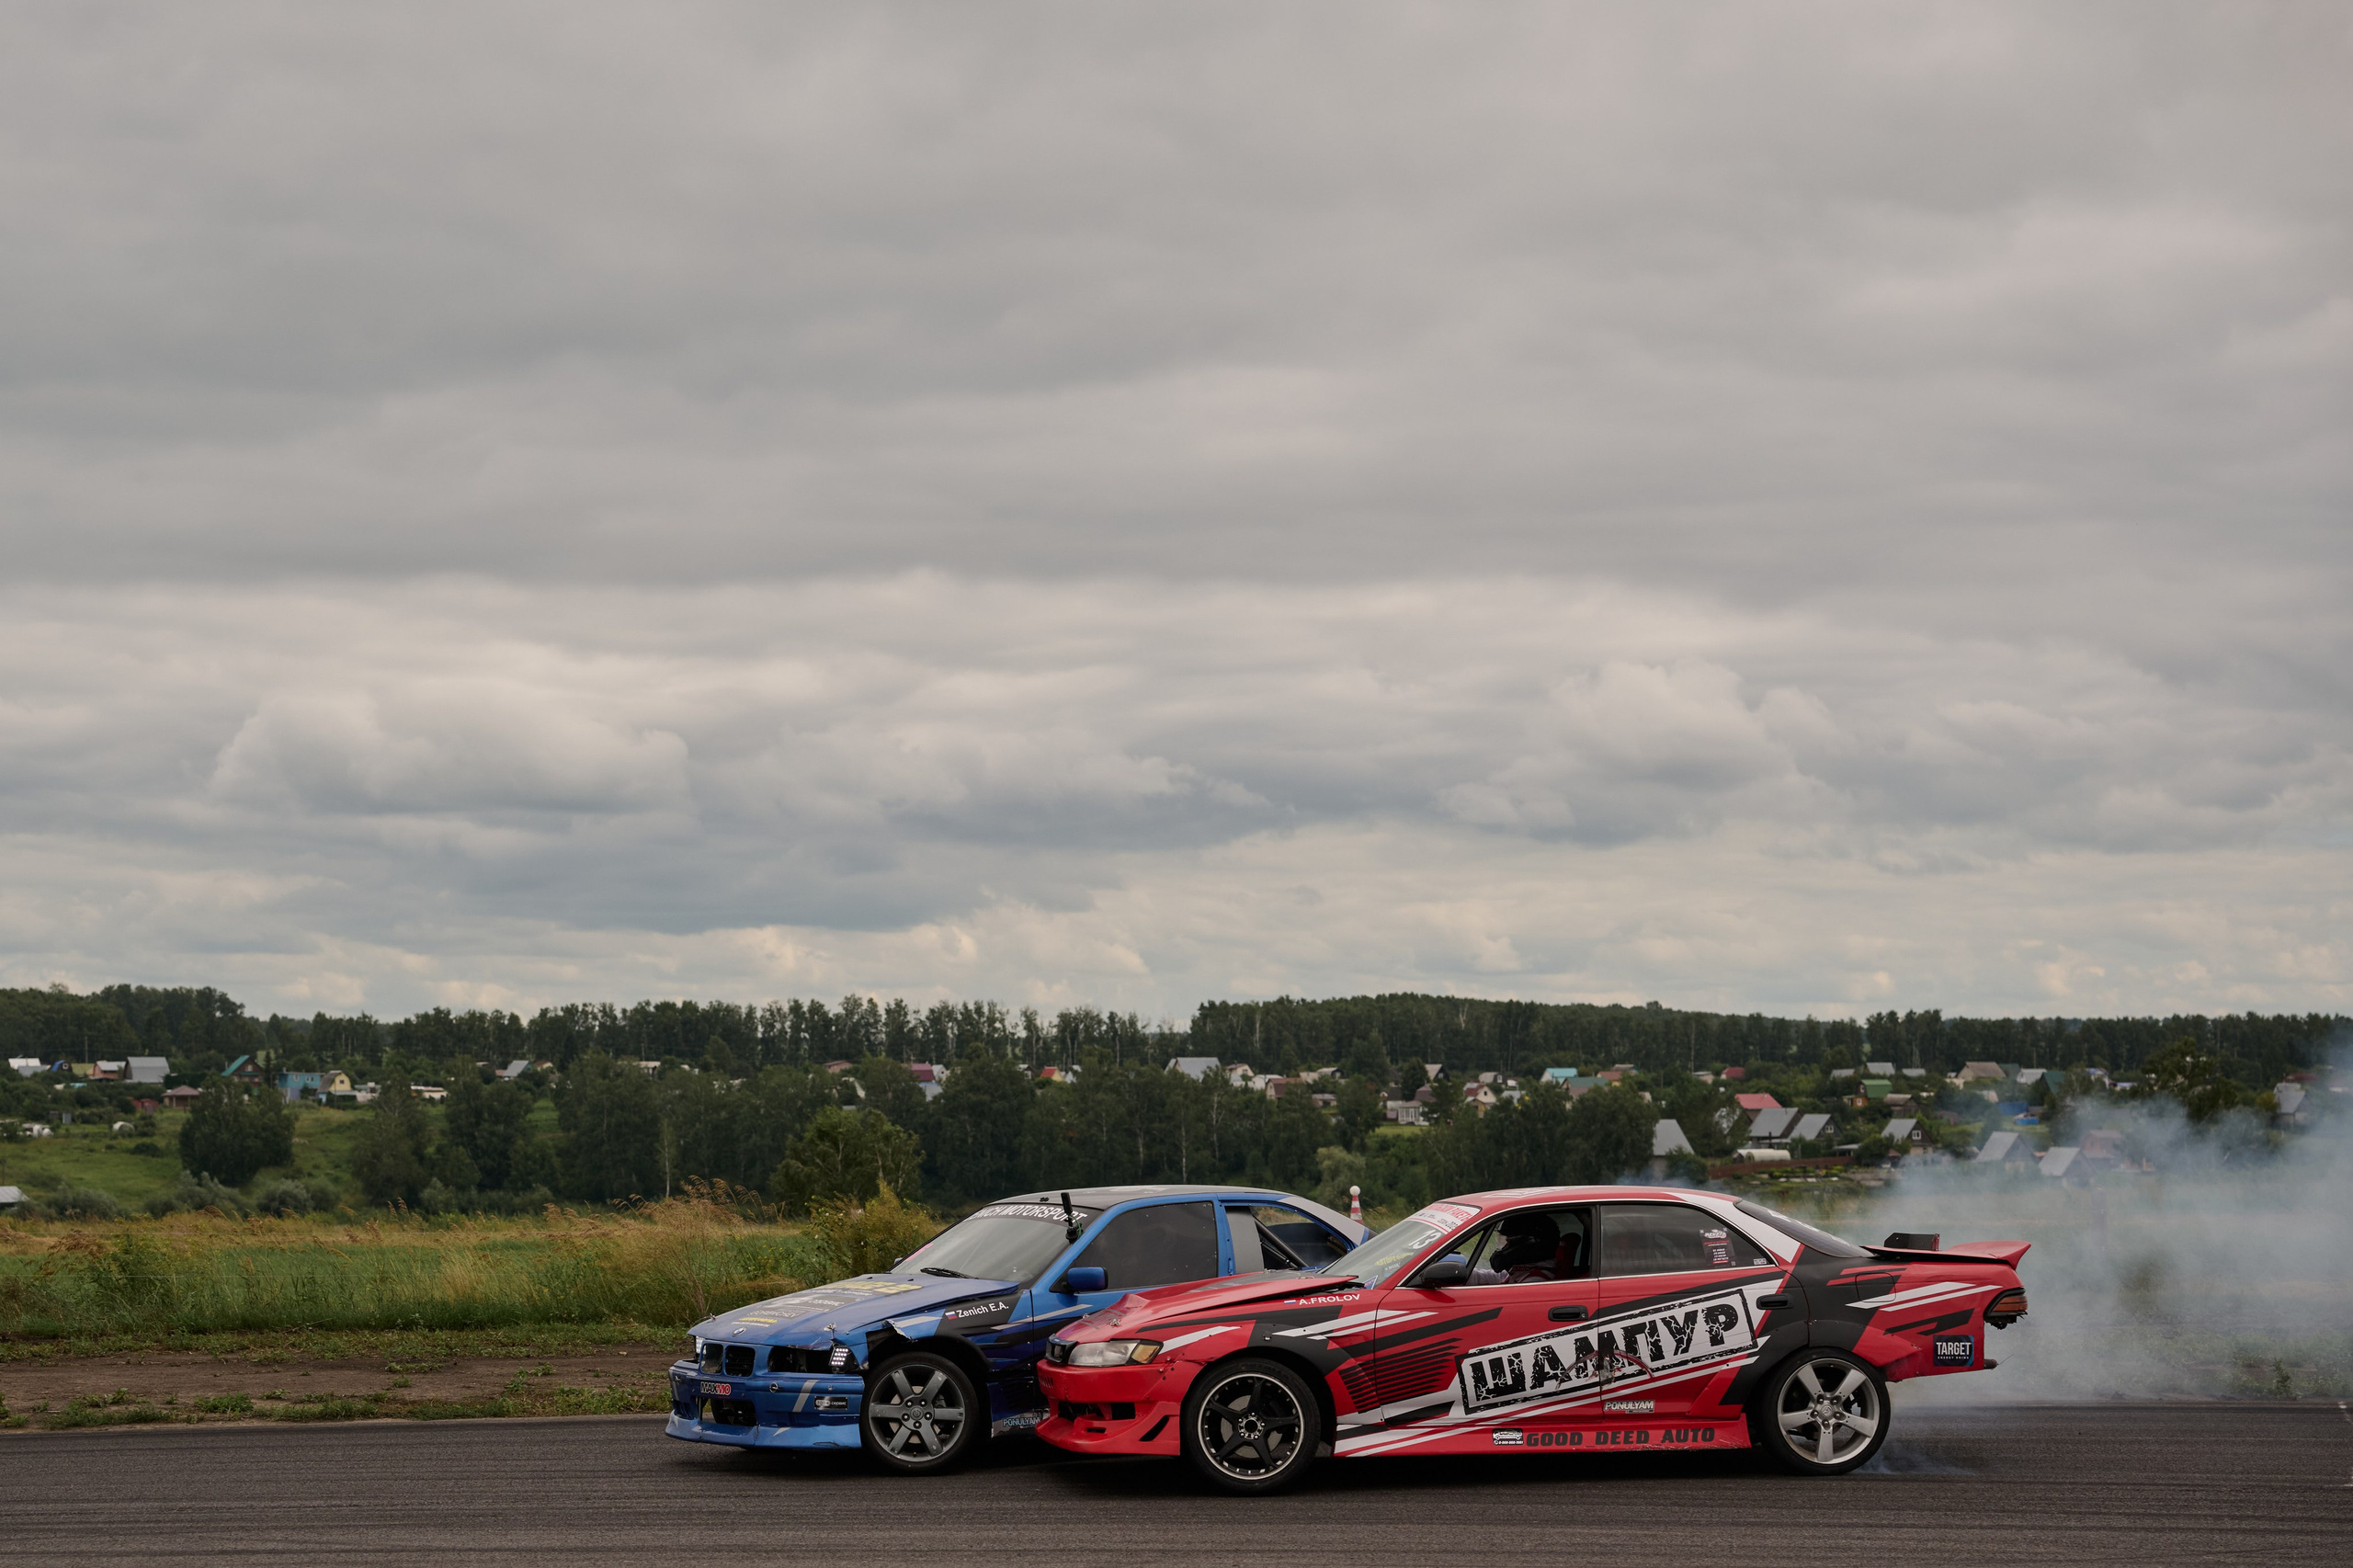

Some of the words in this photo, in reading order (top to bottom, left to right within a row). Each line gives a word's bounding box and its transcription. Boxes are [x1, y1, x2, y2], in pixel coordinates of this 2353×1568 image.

[1000, 1205, 1087, 1222] MOTORSPORT
[1408, 1229, 1442, 1249] 13
[1299, 1294, 1360, 1305] A.FROLOV
[956, 1305, 989, 1318] Zenich
[989, 1301, 1009, 1312] E.A.
[1470, 1303, 1739, 1402] ШАМПУР
[1936, 1342, 1972, 1355] TARGET
[700, 1381, 731, 1395] MAXMO
[1604, 1401, 1654, 1410] PONULYAM
[1003, 1417, 1041, 1426] PONULYAM
[1526, 1432, 1583, 1447] GOOD
[1595, 1430, 1650, 1445] DEED
[1661, 1427, 1715, 1444] AUTO
